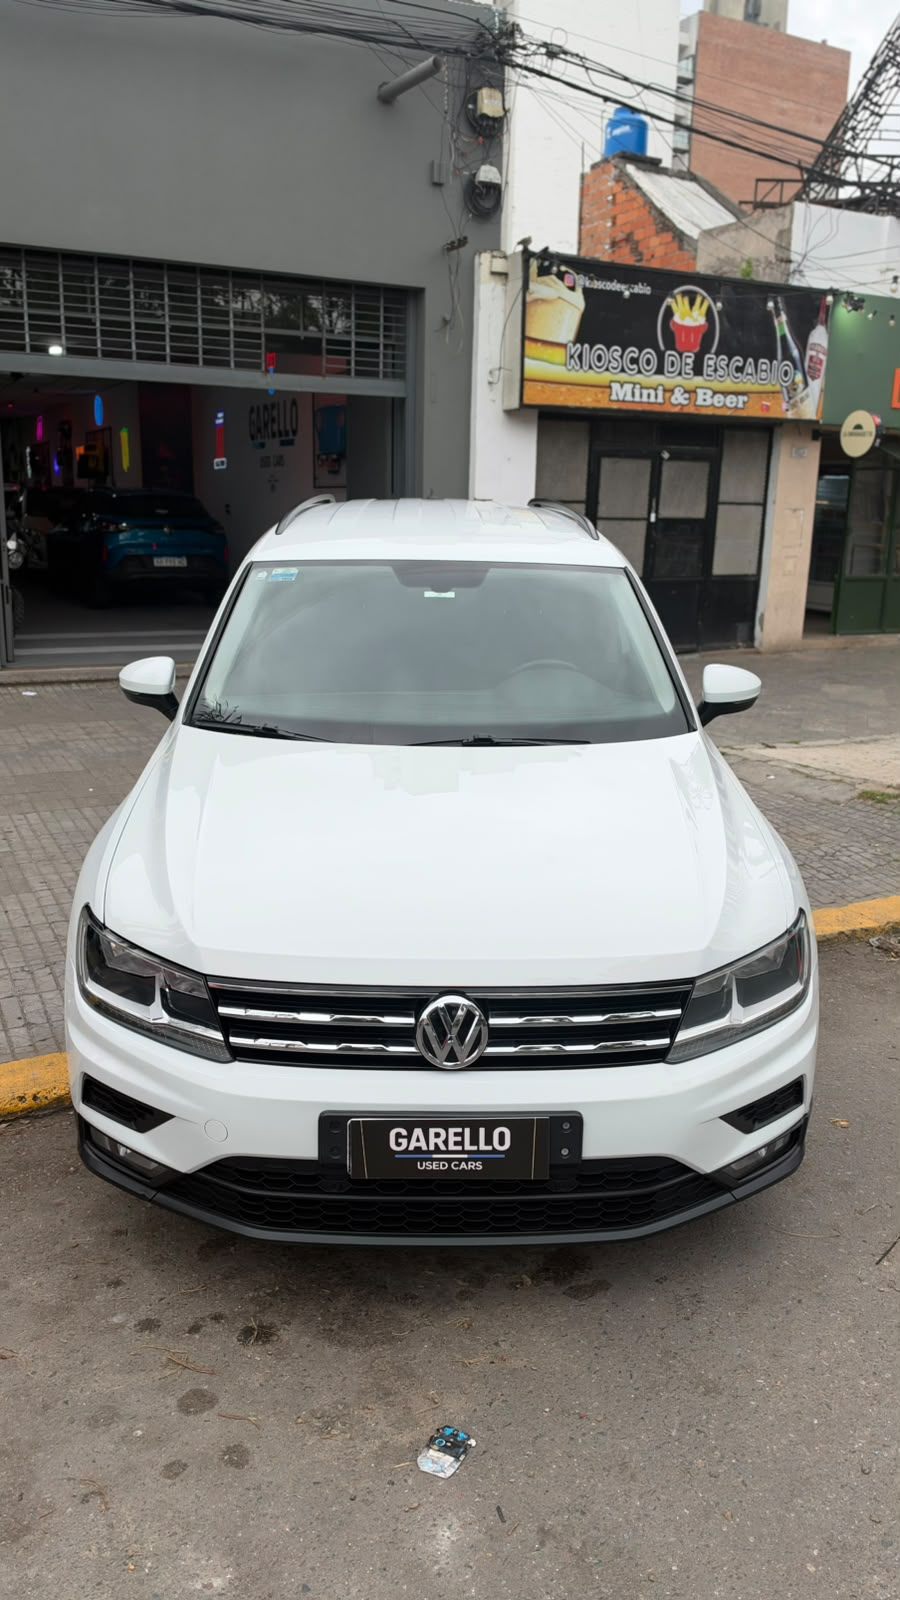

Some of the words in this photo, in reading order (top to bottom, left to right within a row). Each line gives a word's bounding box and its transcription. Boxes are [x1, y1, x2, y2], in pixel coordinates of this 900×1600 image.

[566, 342, 658, 376] KIOSCO
[663, 350, 696, 379] DE
[703, 353, 794, 386] ESCABIO
[609, 381, 665, 405] Mini
[669, 386, 691, 406] &
[694, 387, 749, 410] Beer
[249, 399, 298, 441] GARELLO
[389, 1126, 511, 1151] GARELLO
[417, 1161, 448, 1170] USED
[451, 1161, 483, 1170] CARS
